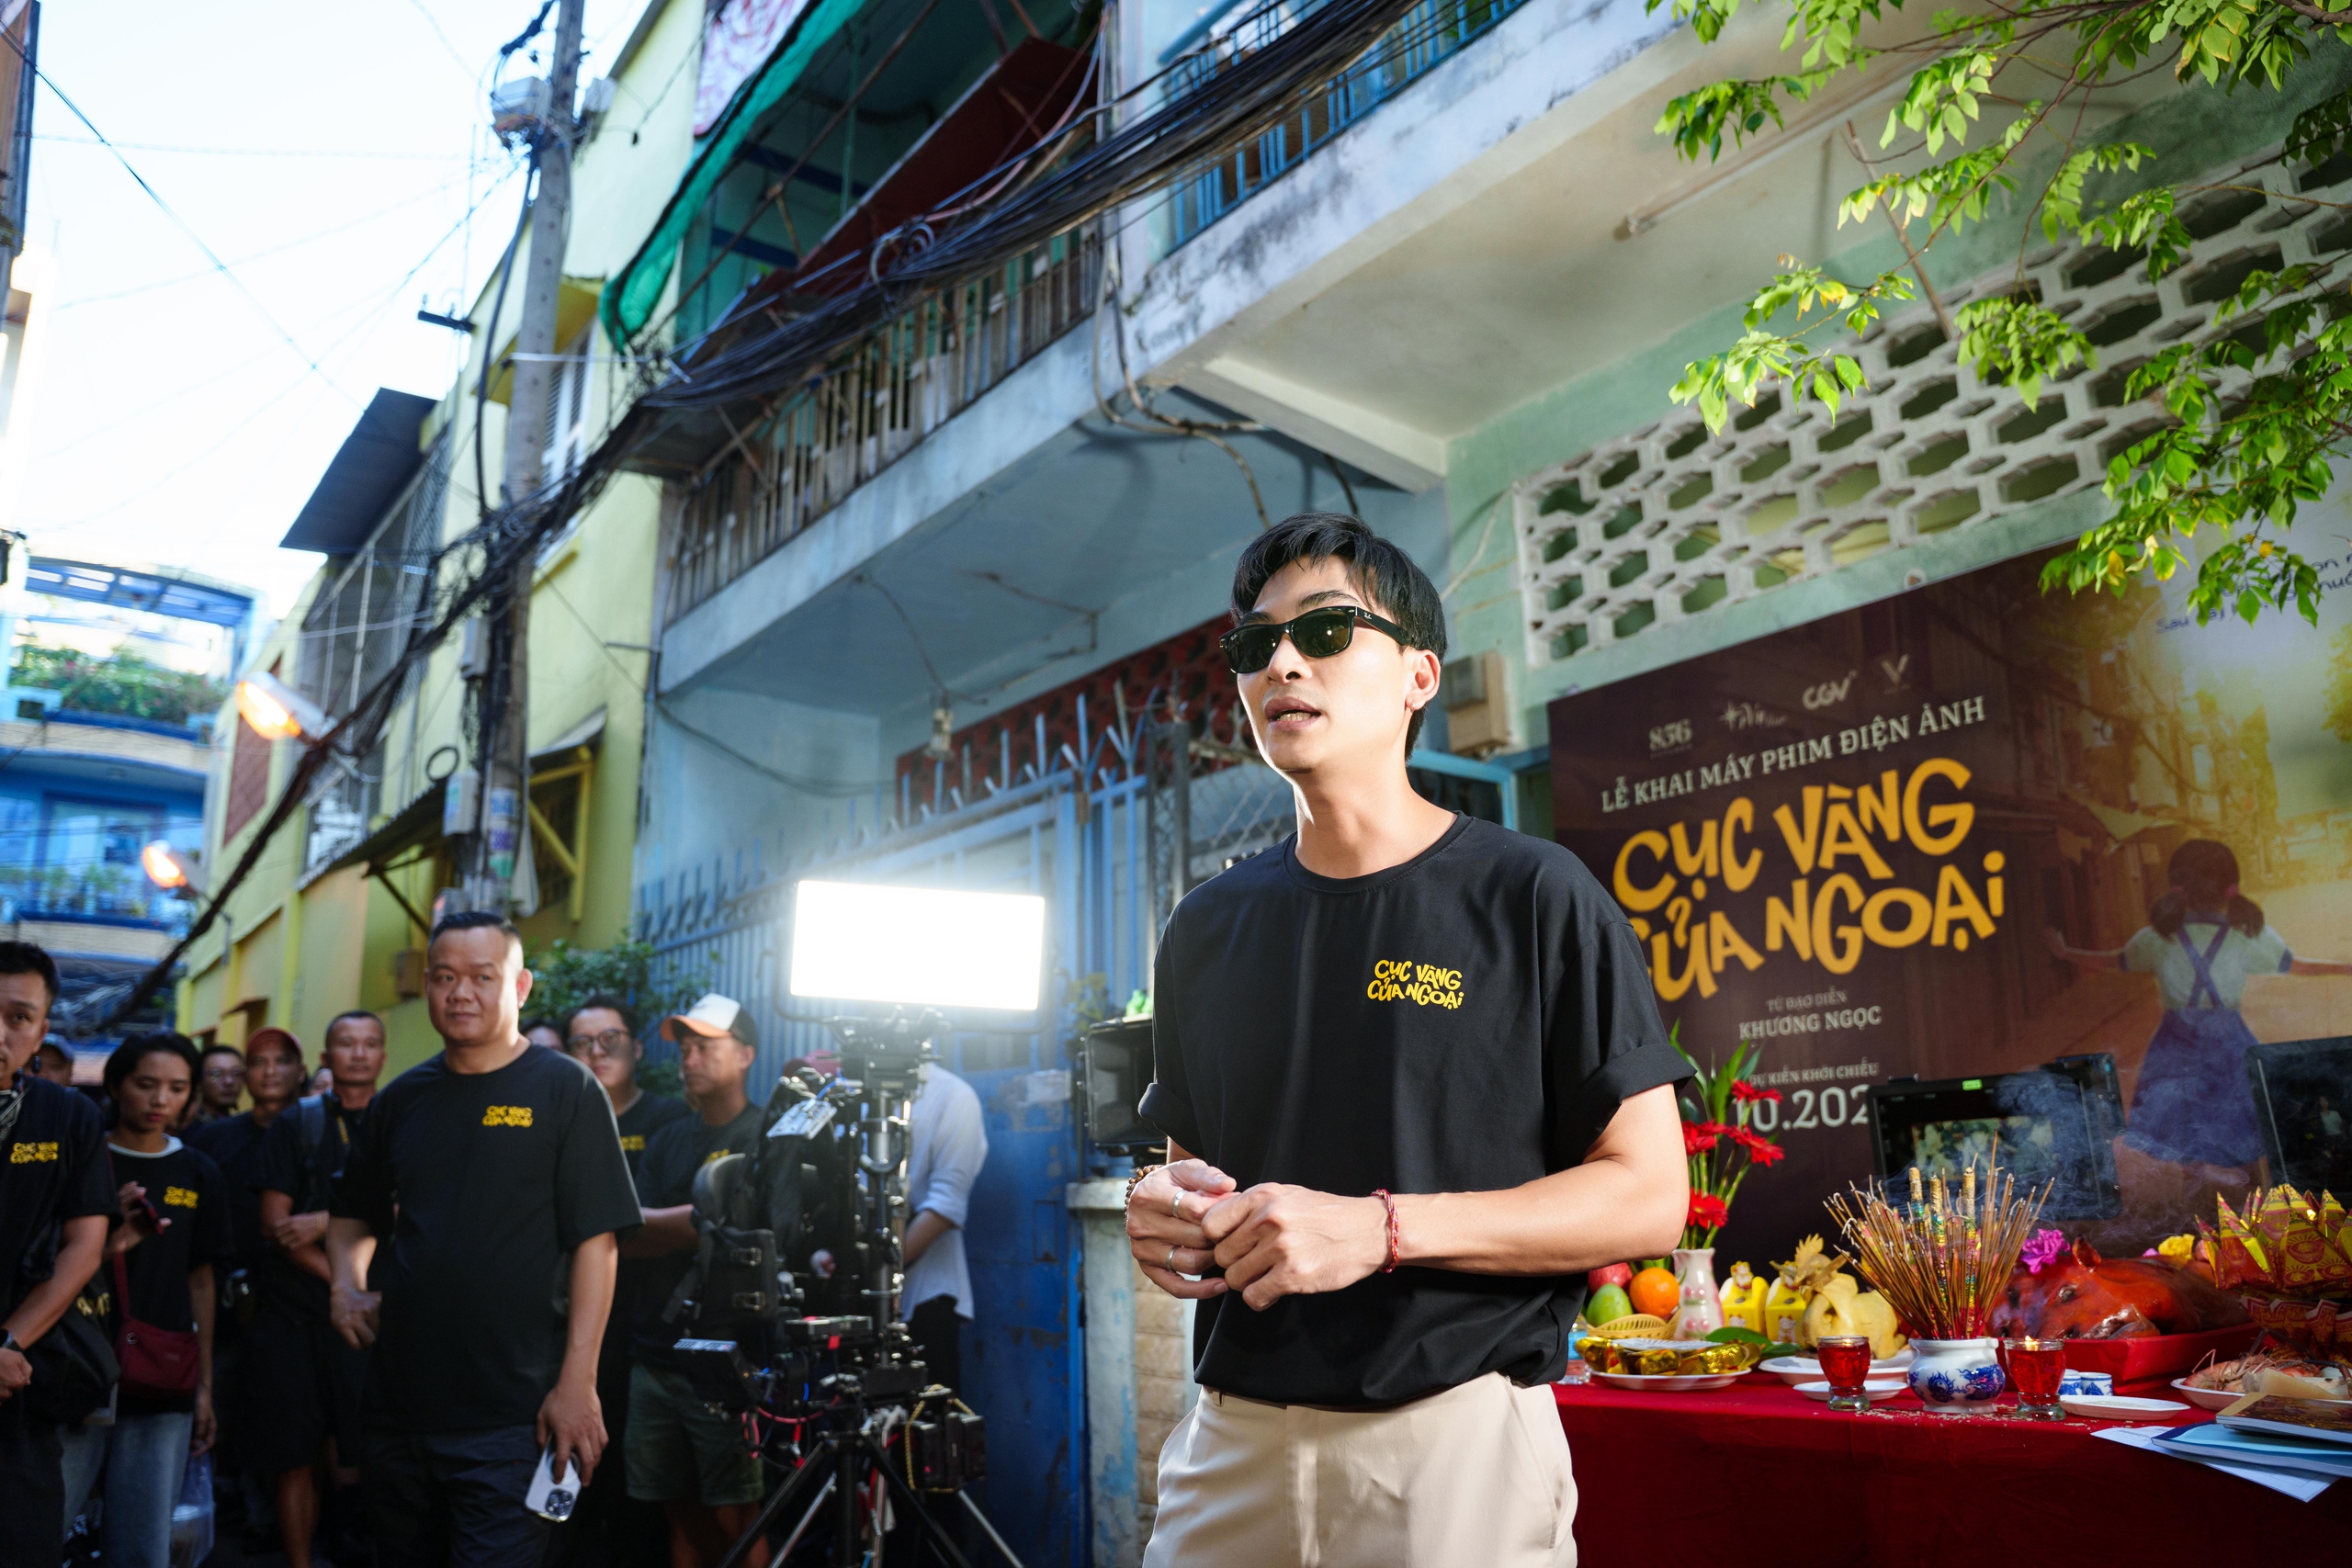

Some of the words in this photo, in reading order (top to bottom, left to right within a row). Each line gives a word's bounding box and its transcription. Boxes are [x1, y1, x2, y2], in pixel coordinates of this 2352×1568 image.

[1802, 675, 1852, 711] CGV
[1600, 775, 1631, 813] LỄ
[1634, 770, 1695, 807] KHAI
[1699, 752, 1757, 790] MÁY
[1760, 734, 1835, 775] PHIM
[1839, 714, 1911, 755] ĐIỆN
[1917, 694, 1986, 737] ẢNH
[1612, 796, 1764, 912] CỤC
[1772, 757, 1975, 880] VÀNG
[1367, 976, 1406, 1001] CỦA
[1374, 959, 1413, 982] CỤC
[1416, 964, 1463, 990] VÀNG
[1738, 1013, 1822, 1040] KHƯƠNG
[1824, 1005, 1883, 1031] NGỌC
